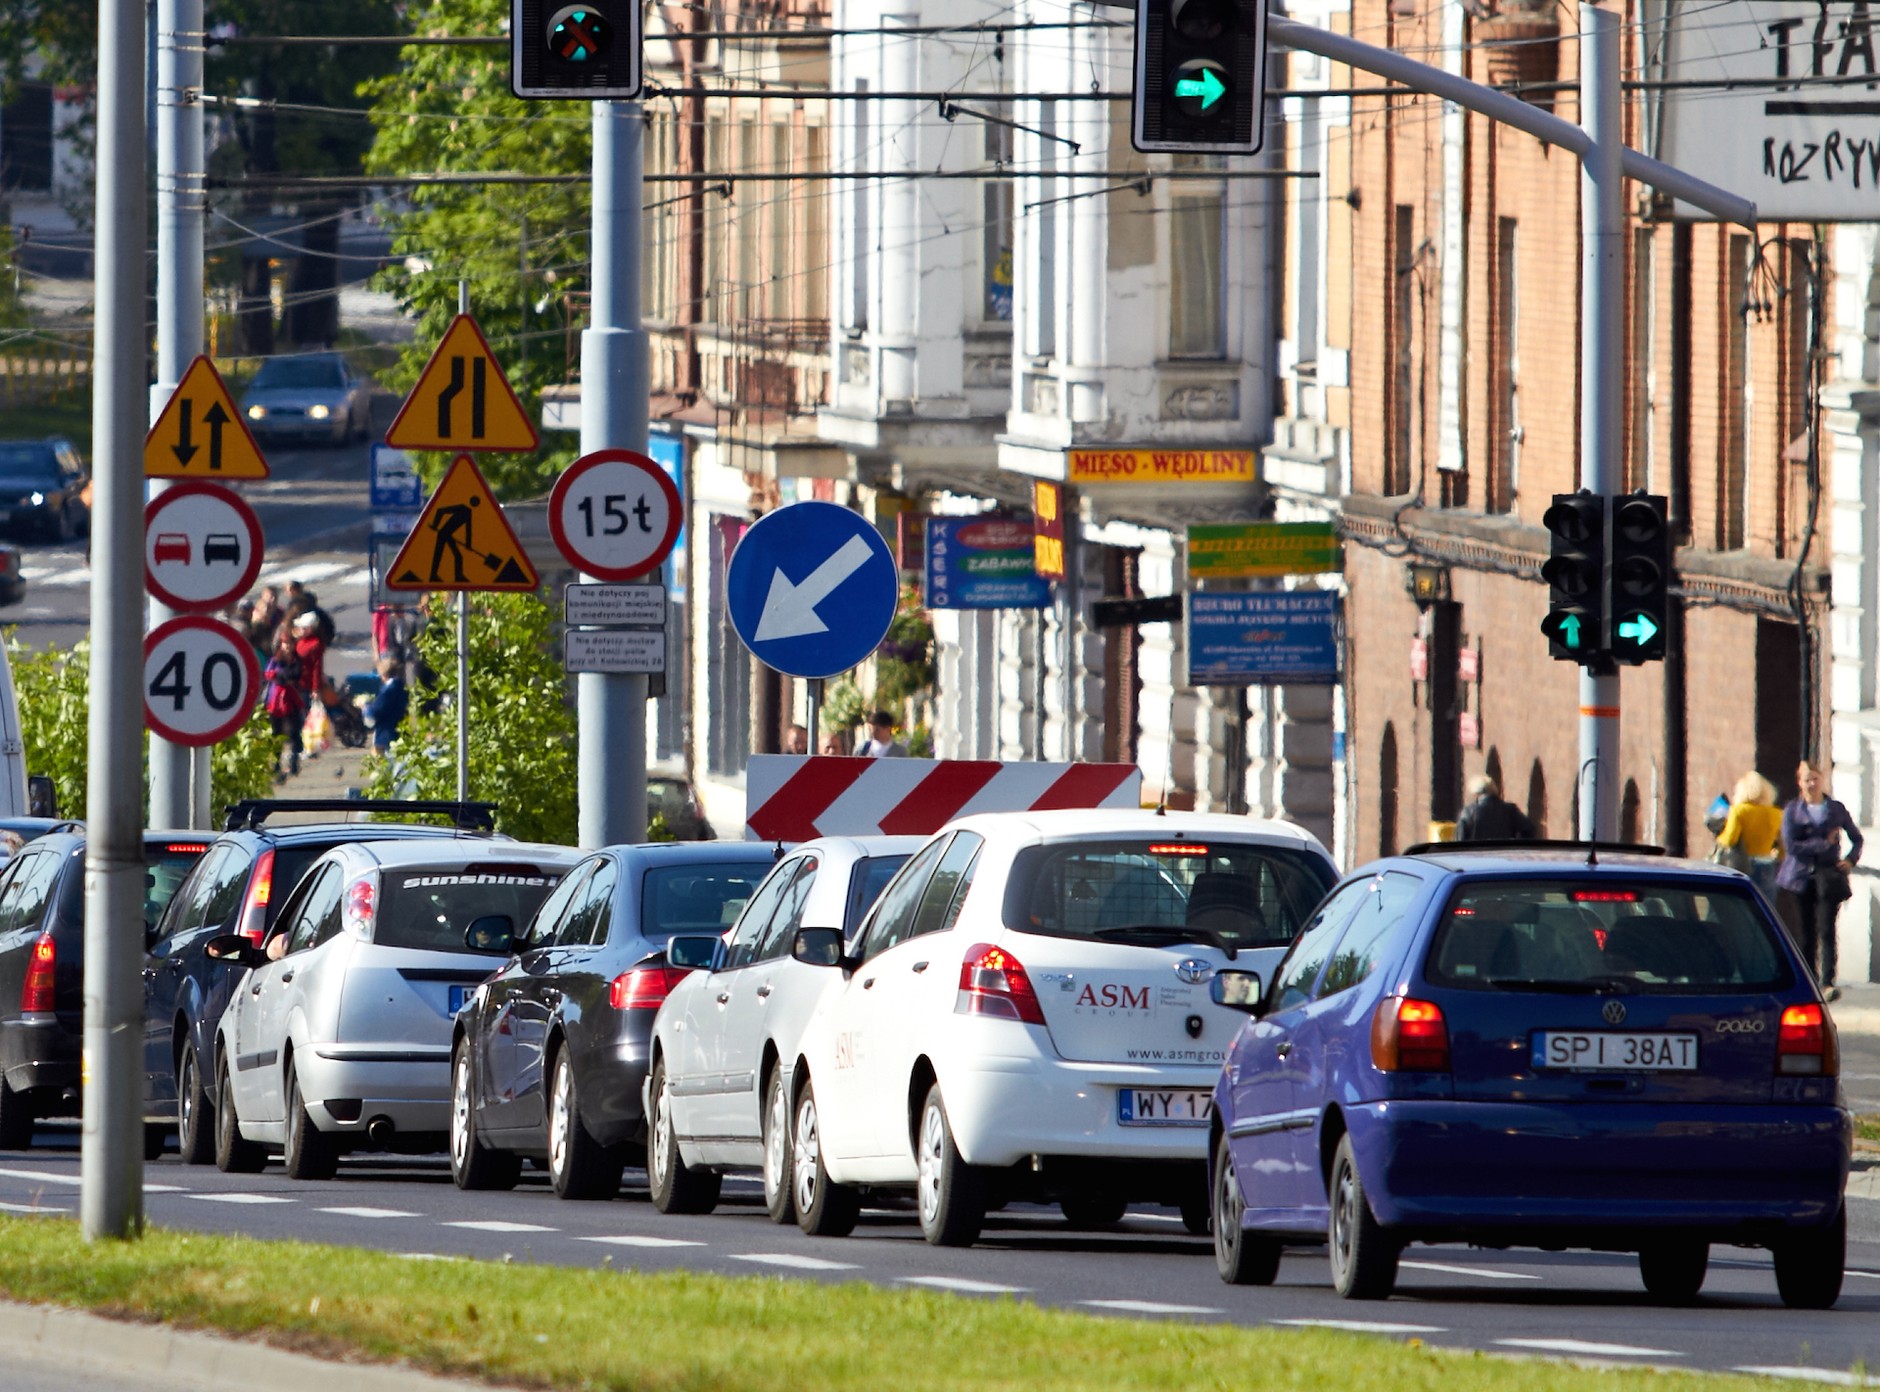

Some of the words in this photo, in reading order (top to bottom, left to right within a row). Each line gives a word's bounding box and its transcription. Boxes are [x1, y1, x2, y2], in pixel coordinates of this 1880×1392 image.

[1074, 453, 1137, 478] MIĘSO
[1152, 453, 1249, 478] WĘDLINY
[577, 493, 653, 537] 15t
[968, 557, 1035, 571] ZABAWK
[569, 601, 622, 609] komunikacji
[625, 601, 663, 609] miejskiej
[581, 589, 595, 597] Nie
[598, 589, 632, 598] dotyczy
[576, 636, 590, 645] Nie
[149, 651, 242, 711] 40
[403, 874, 545, 889] sunshine
[1075, 983, 1151, 1009] ASM
[1550, 1036, 1605, 1065] SPI
[1622, 1038, 1694, 1067] 38AT
[1138, 1093, 1174, 1118] WY
[1187, 1093, 1213, 1119] 17
